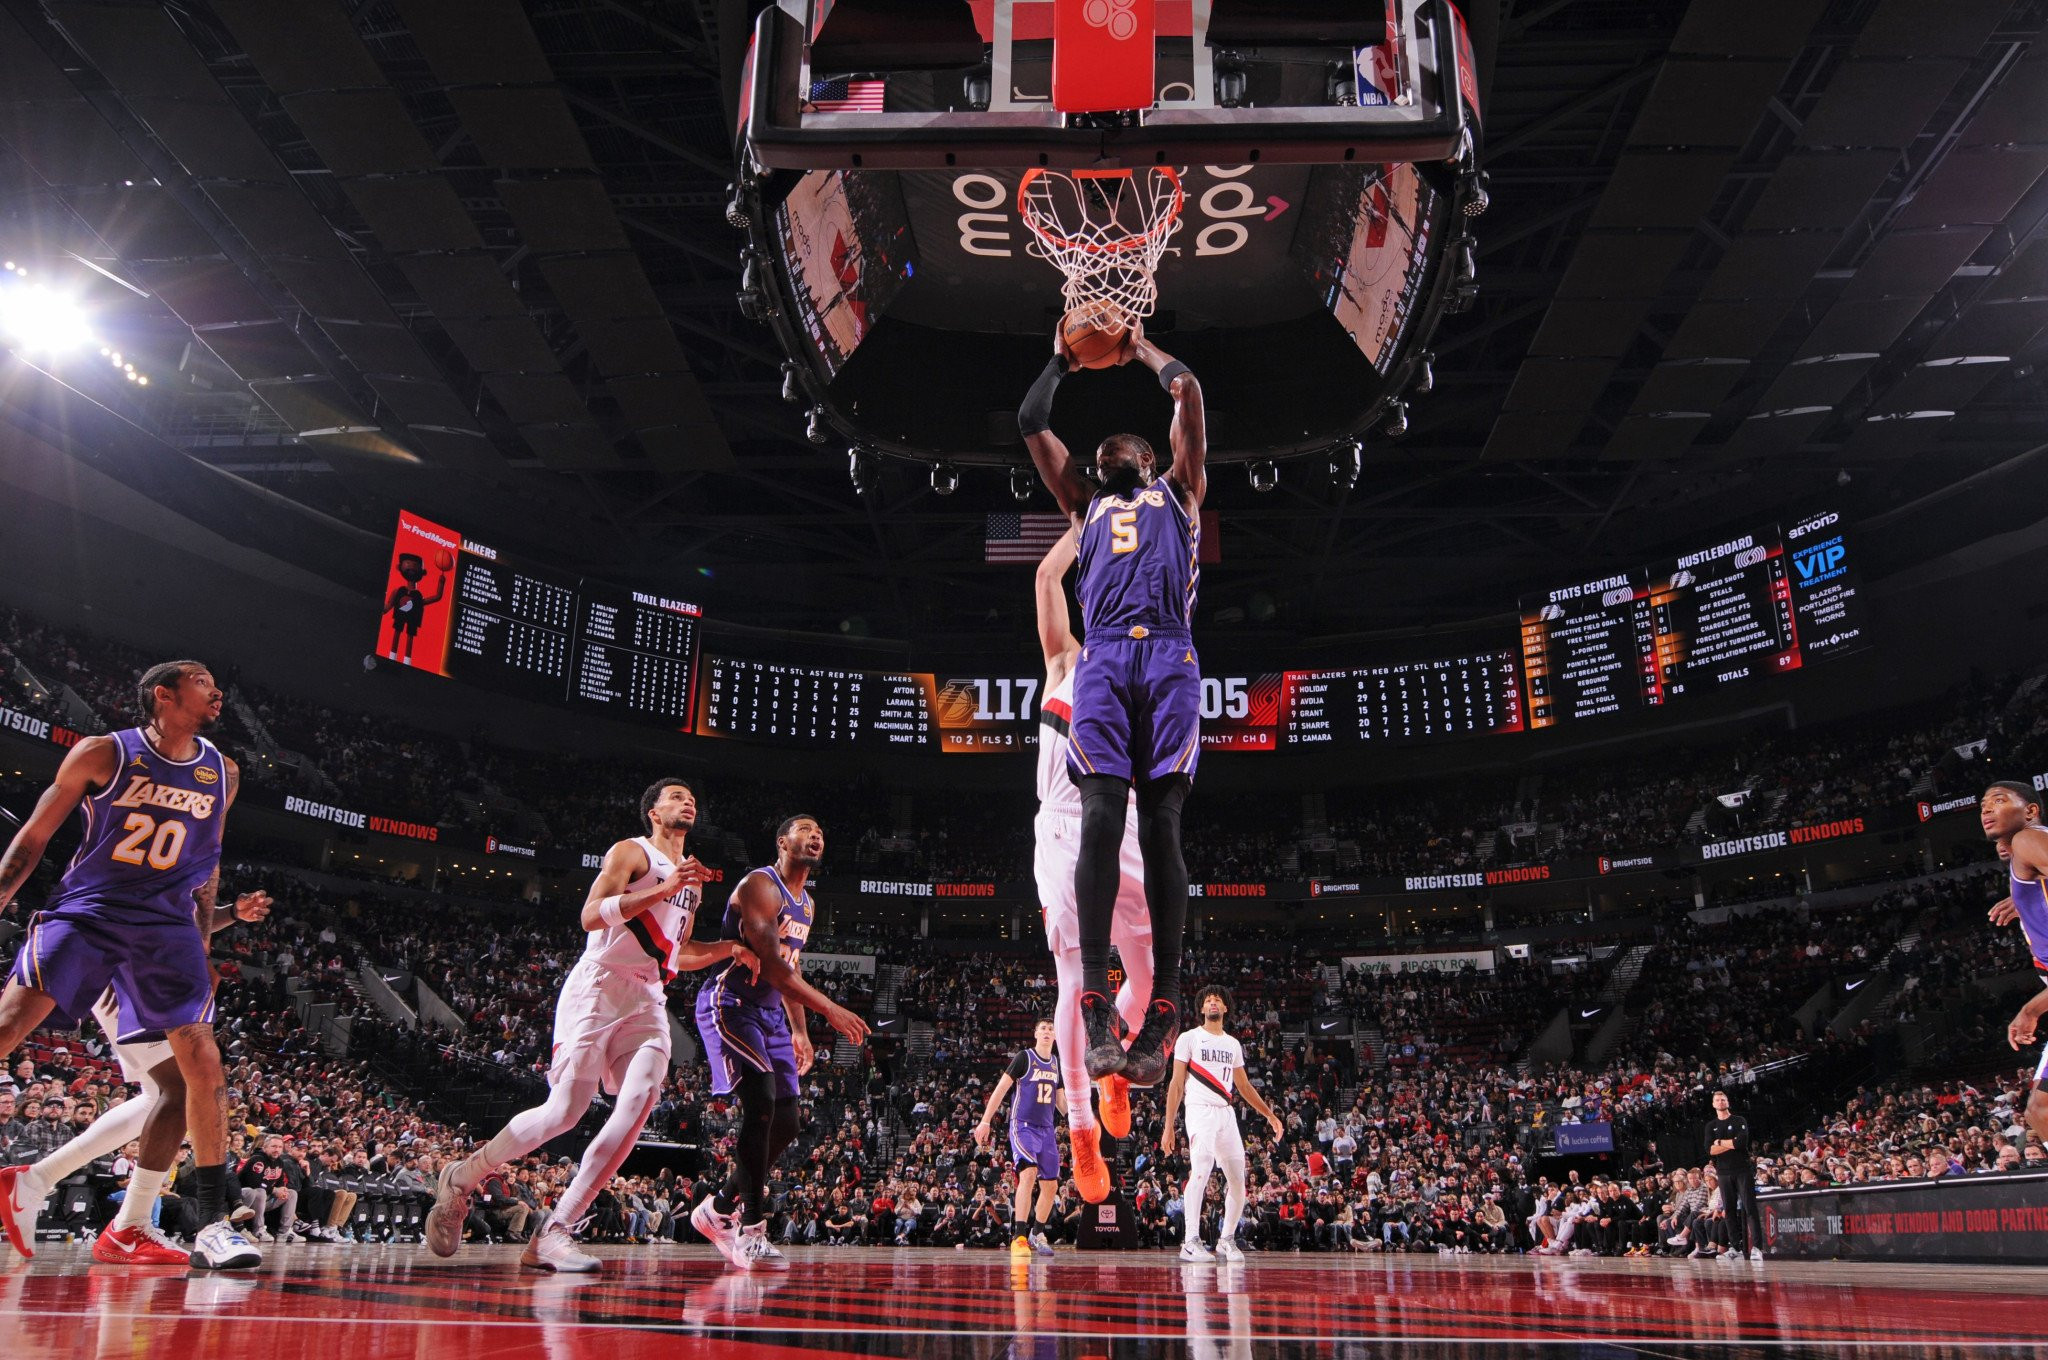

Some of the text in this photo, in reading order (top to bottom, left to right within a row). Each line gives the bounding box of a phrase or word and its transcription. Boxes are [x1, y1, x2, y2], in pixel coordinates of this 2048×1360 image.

[1363, 93, 1383, 104] NBA
[952, 174, 1012, 256] mo
[1376, 288, 1390, 344] moda
[1111, 510, 1138, 554] 5
[1788, 512, 1839, 539] BEYOND
[464, 540, 496, 560] LAKERS
[1678, 535, 1752, 570] HUSTLEBOARD
[1792, 536, 1842, 560] EXPERIENCE
[1794, 545, 1846, 579] VIP
[1695, 572, 1744, 592] BLOCKED SHOTS
[1798, 566, 1847, 588] TREATMENT
[1550, 574, 1630, 602] STATS CENTRAL
[1710, 587, 1732, 598] STEALS
[1810, 584, 1842, 600] BLAZERS
[632, 592, 698, 614] TRAIL BLAZERS
[1700, 593, 1746, 612] OFF REBOUNDS
[1799, 588, 1856, 612] PORTLAND FIRE
[1698, 602, 1750, 623] 2ND CHANCE PTS
[1813, 602, 1844, 617] TIMBERS
[1566, 614, 1600, 626] FIELD GOAL
[1700, 614, 1750, 632] CHARGES TAKEN
[1815, 610, 1846, 626] THORNS
[1550, 620, 1617, 638] EFFECTIVE FIELD GOAL
[1696, 622, 1758, 644] FORCED TURNOVERS
[1567, 630, 1610, 645] FREE THROWS
[1692, 630, 1766, 656] POINTS OFF TURNOVERS
[1810, 638, 1828, 650] First
[1840, 628, 1859, 640] Tech
[1572, 643, 1608, 656] 3-POINTERS
[1687, 639, 1774, 668] 24-SEC VIOLATIONS FORCED
[1566, 659, 1588, 668] POINTS
[1598, 653, 1616, 663] PAINT
[1780, 656, 1790, 666] 89
[1312, 672, 1346, 680] BLAZERS
[1394, 665, 1408, 673] AST
[1562, 662, 1622, 680] FAST BREAK POINTS
[1718, 667, 1749, 682] TOTALS
[1578, 675, 1610, 686] REBOUNDS
[1300, 685, 1328, 693] HOLIDAY
[1582, 686, 1607, 696] ASSISTS
[1672, 684, 1684, 694] 88
[886, 698, 926, 707] LARAVIA 12
[973, 679, 1038, 720] 117
[1291, 698, 1295, 706] 8
[1576, 694, 1615, 707] TOTAL FOULS
[880, 710, 902, 718] SMITH
[1292, 709, 1323, 718] 9 GRANT
[1575, 704, 1619, 718] BENCH POINTS
[874, 722, 927, 731] HACHIMURA 28
[966, 735, 973, 745] 2
[1006, 735, 1012, 745] 3
[1260, 733, 1267, 743] 0
[1302, 734, 1332, 742] CAMARA
[196, 770, 217, 779] bibigo
[111, 775, 216, 820] LAKERS
[1932, 795, 1976, 813] BRIGHTSIDE
[284, 796, 438, 842] BRIGHTSIDE WINDOWS
[111, 812, 187, 870] 20
[1702, 817, 1864, 860] BRIGHTSIDE WINDOWS
[498, 843, 536, 857] BRIGHTSIDE
[1612, 856, 1652, 868] BRIGHTSIDE
[1405, 866, 1550, 890] BRIGHTSIDE WINDOWS
[860, 880, 995, 896] BRIGHTSIDE WINDOWS
[1206, 884, 1266, 896] WINDOWS
[1323, 884, 1360, 892] BRIGHTSIDE
[806, 959, 832, 970] CITY
[1421, 958, 1449, 970] CITY
[1450, 957, 1478, 969] ROW
[1108, 970, 1122, 981] 20
[1200, 1048, 1234, 1065] BLAZERS
[1222, 1067, 1232, 1082] 17
[1037, 1083, 1053, 1104] 12
[1572, 1134, 1609, 1145] luckin coffee
[1778, 1216, 1815, 1233] BRIGHTSIDE
[1826, 1215, 1843, 1234] THE
[1844, 1213, 1892, 1235] EXCLUSIVE
[1894, 1212, 1939, 1233] WINDOW
[1941, 1210, 1964, 1232] AND
[1966, 1209, 1998, 1232] DOOR
